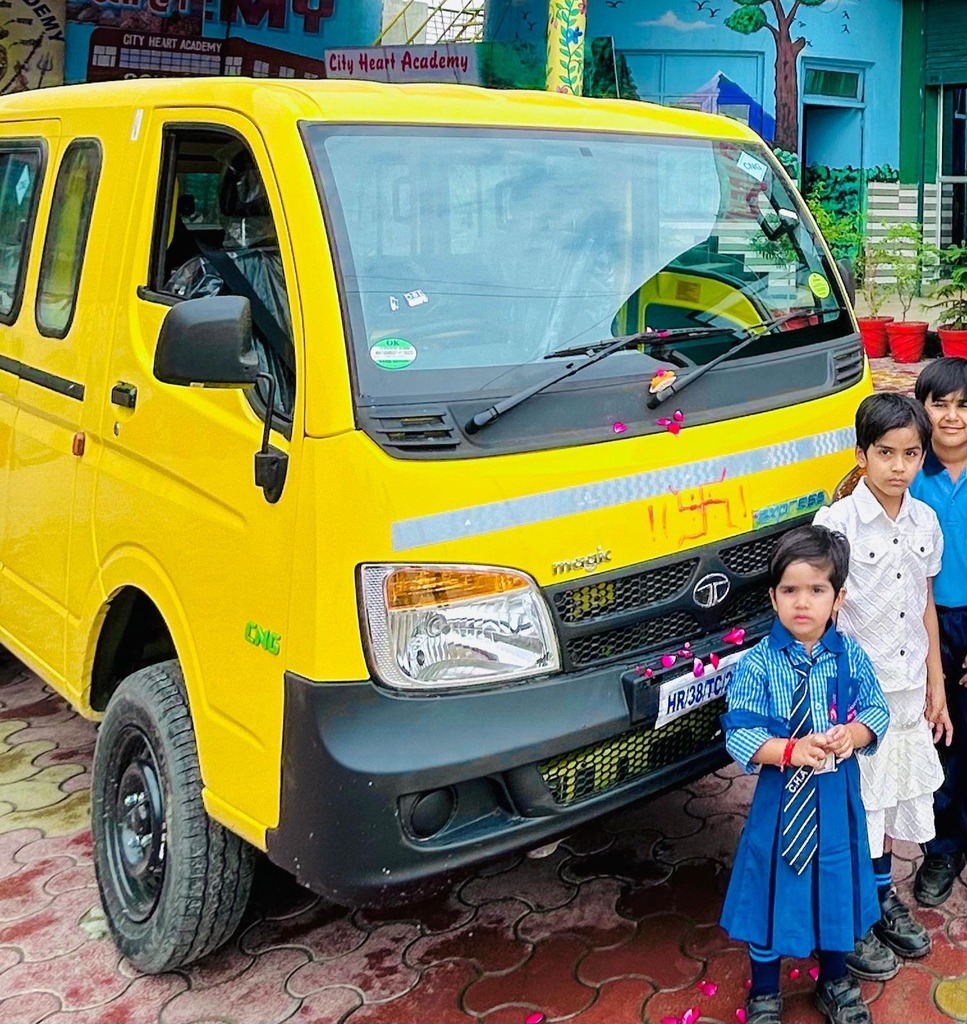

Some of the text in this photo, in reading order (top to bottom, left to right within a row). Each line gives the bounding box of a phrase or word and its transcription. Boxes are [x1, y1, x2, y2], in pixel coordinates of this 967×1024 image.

[122, 33, 223, 54] CITY HEART ACADEMY
[329, 50, 468, 75] City Heart Academy
[552, 545, 612, 576] magic
[244, 621, 282, 656] CNG
